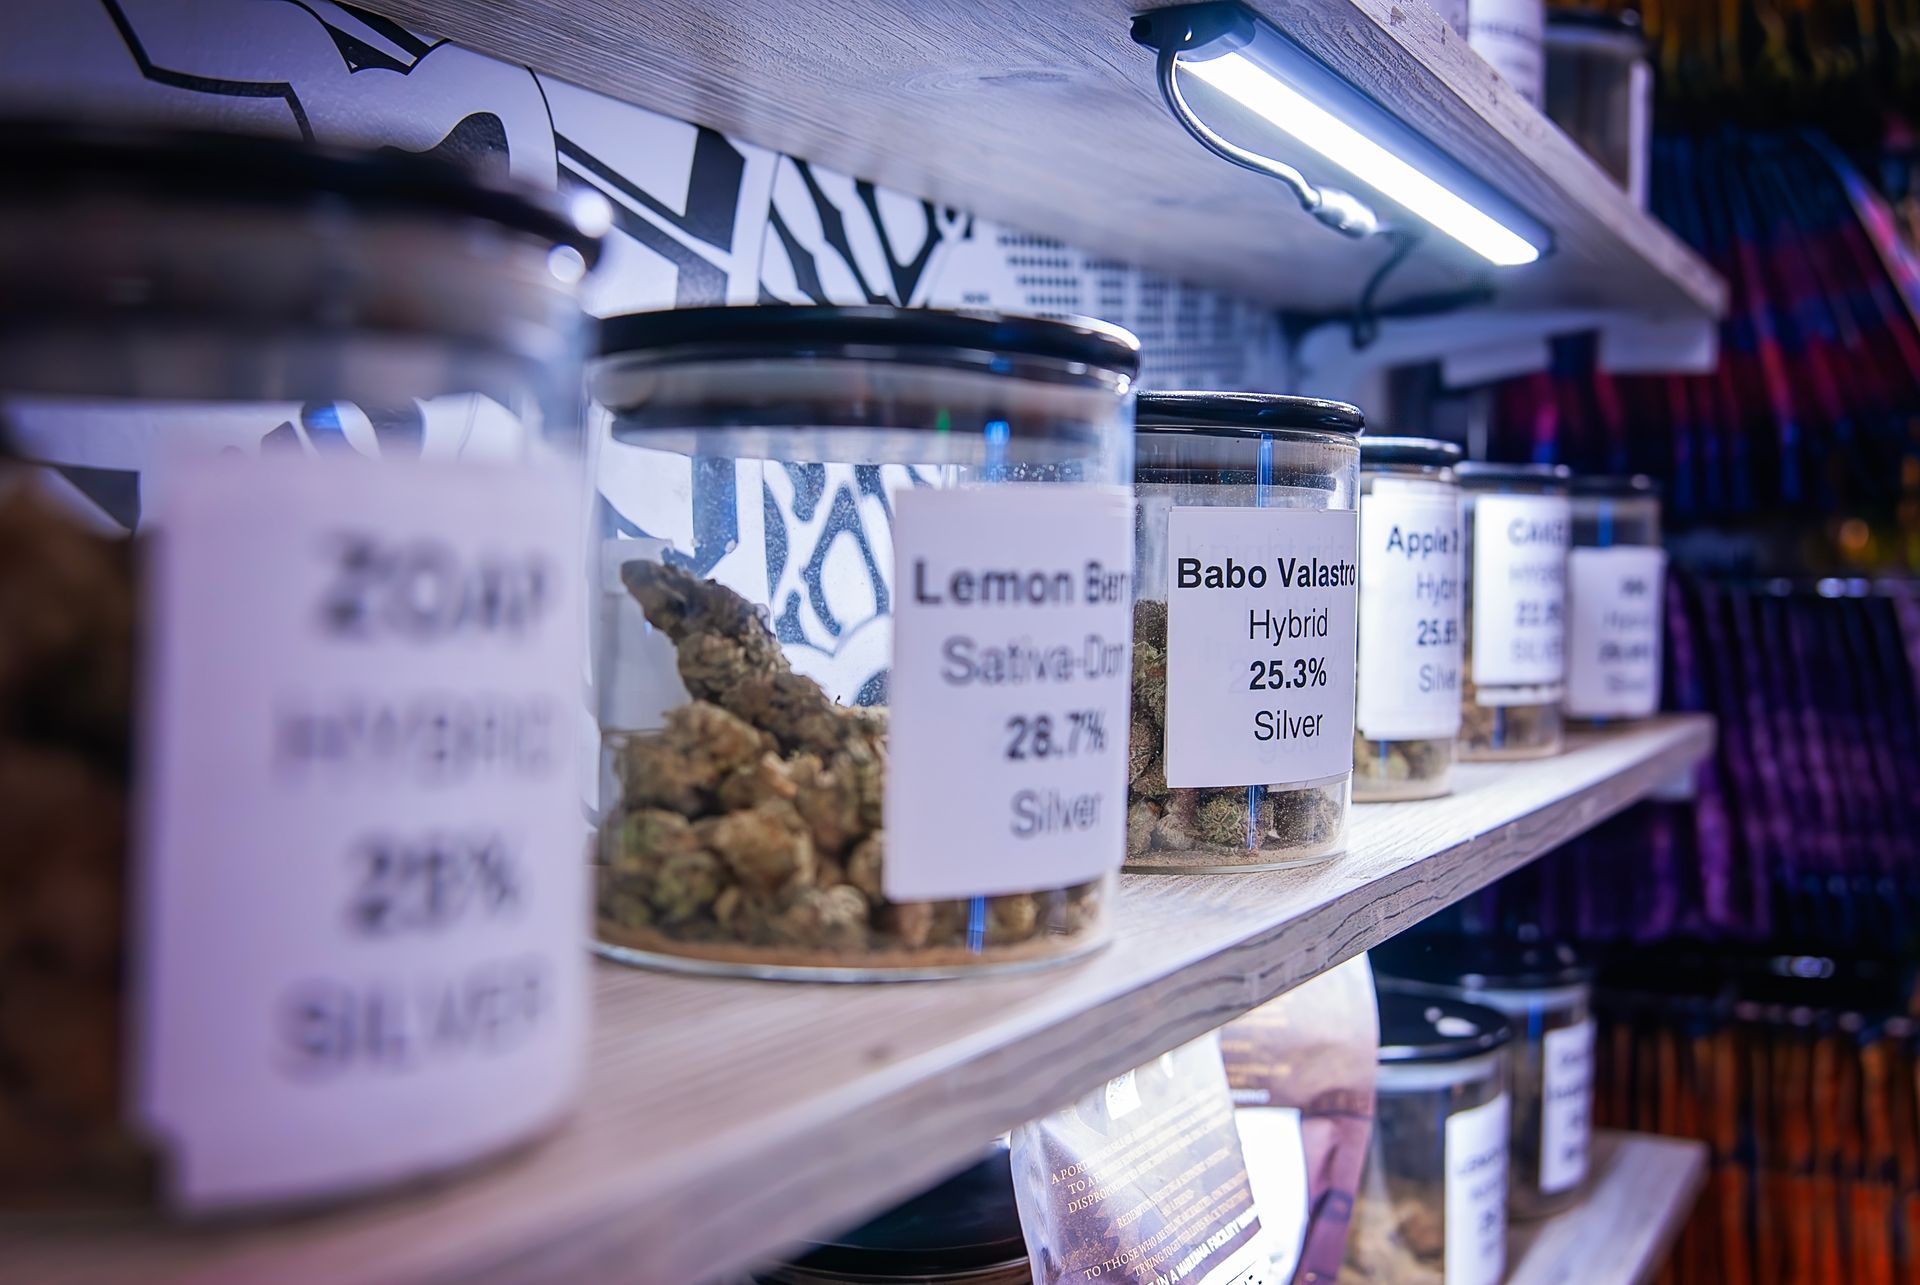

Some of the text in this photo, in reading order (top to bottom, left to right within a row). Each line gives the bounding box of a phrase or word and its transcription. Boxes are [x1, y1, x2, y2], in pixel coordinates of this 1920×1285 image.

[1386, 526, 1449, 559] Apple
[914, 558, 1075, 604] Lemon
[1177, 558, 1356, 589] Babo Valastro
[1249, 608, 1328, 647] Hybrid
[1249, 657, 1327, 690] 25.3%
[1006, 713, 1106, 760] 28.7%
[1253, 709, 1323, 741] Silver
[1010, 790, 1102, 838] Silver
[1067, 1179, 1086, 1195] TO
[1083, 1264, 1102, 1281] TO
[1102, 1247, 1140, 1273] THOSE
[1138, 1236, 1158, 1255] WHO
[1132, 1252, 1165, 1277] TRYING
[1169, 1268, 1181, 1284] A
